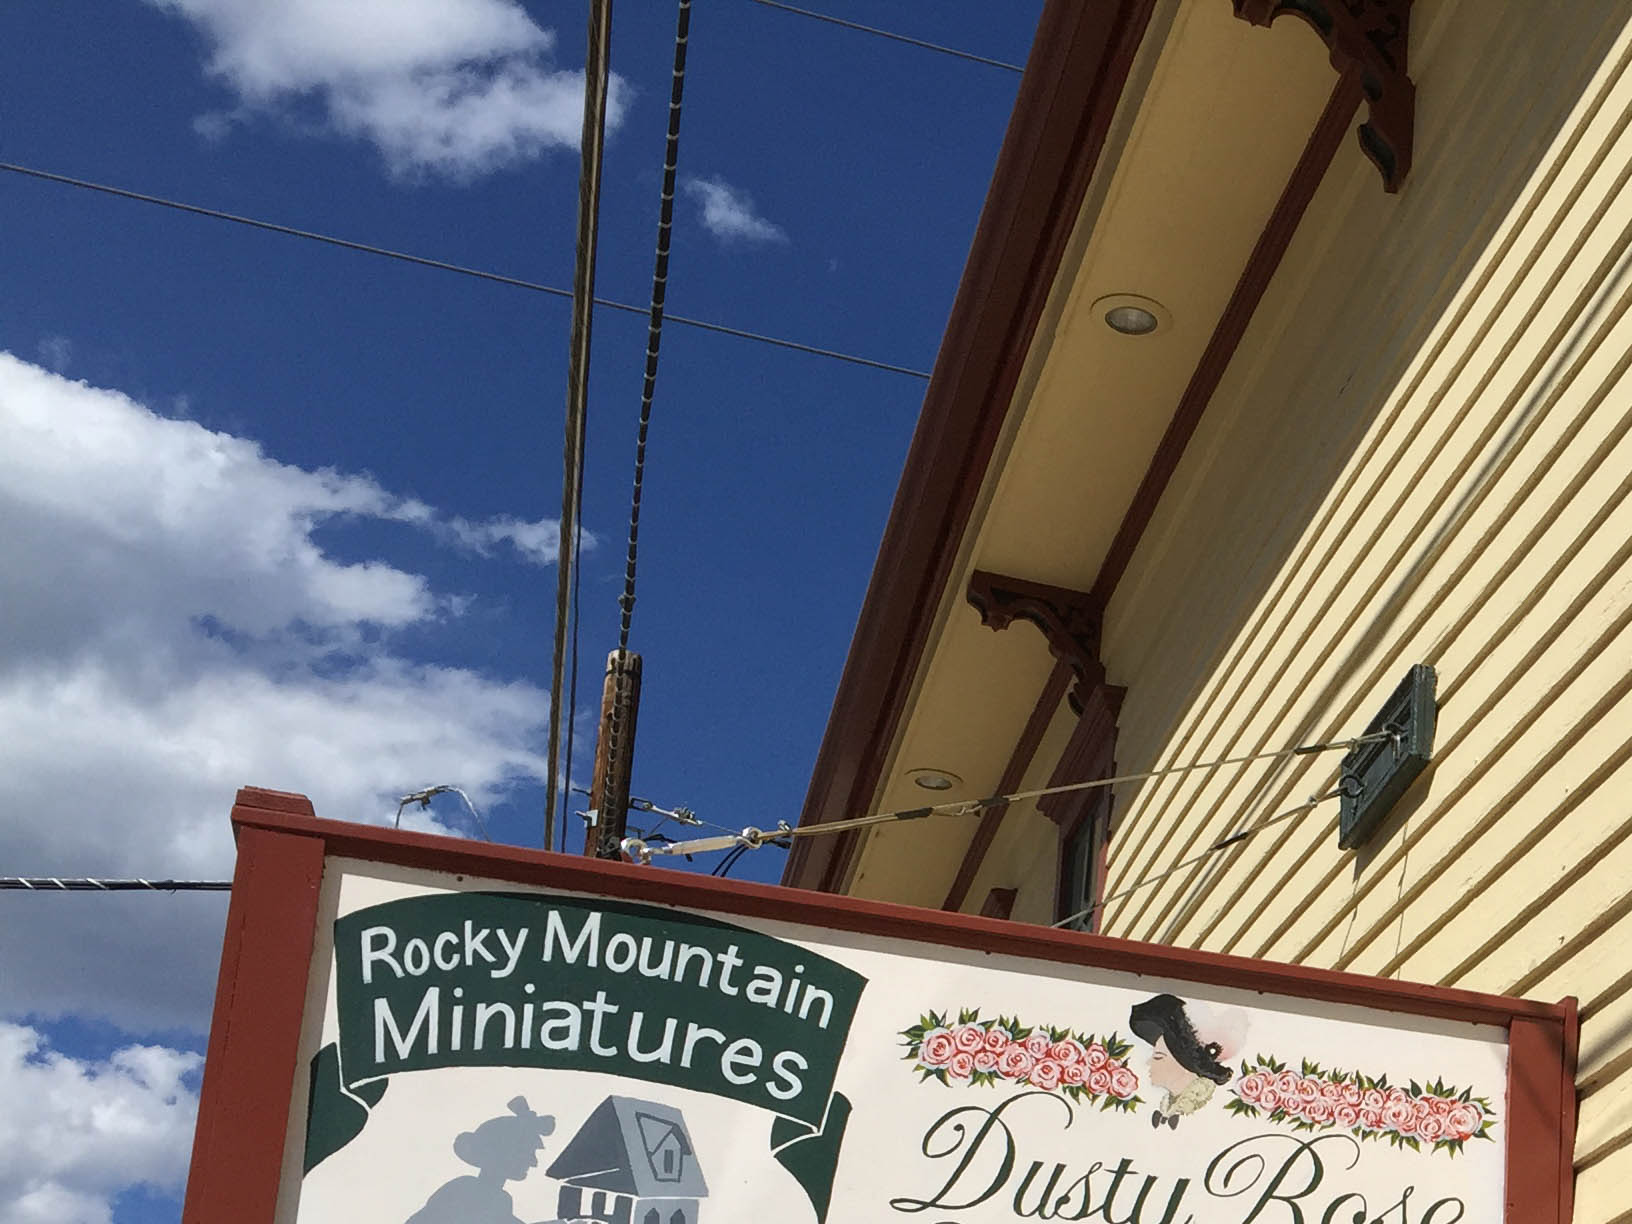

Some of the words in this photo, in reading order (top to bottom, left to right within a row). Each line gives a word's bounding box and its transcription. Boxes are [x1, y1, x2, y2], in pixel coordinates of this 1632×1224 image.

[361, 919, 529, 985] Rocky
[543, 910, 834, 1030] Mountain
[374, 983, 809, 1100] Miniatures
